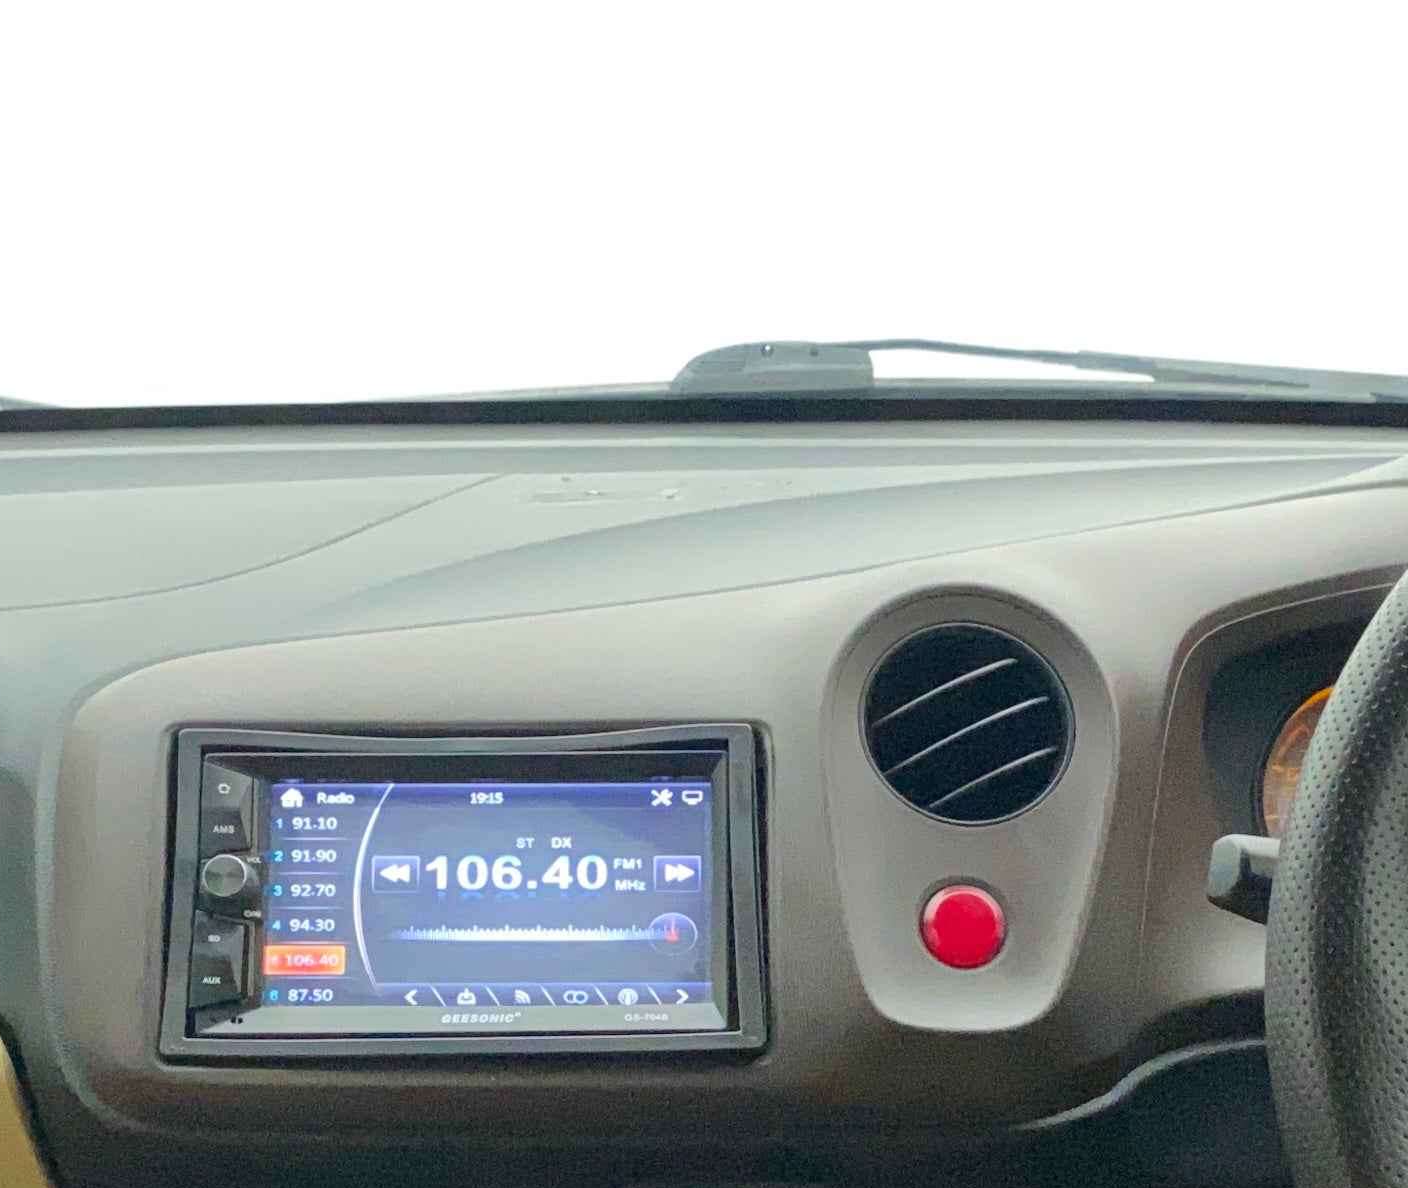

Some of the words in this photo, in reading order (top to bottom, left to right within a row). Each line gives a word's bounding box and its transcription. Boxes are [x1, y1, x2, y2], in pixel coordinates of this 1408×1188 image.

[317, 792, 355, 804] Radio
[470, 792, 504, 804] 19:15
[212, 824, 235, 834] AMS
[276, 819, 283, 829] 1
[292, 816, 338, 830] 91.10
[516, 837, 535, 849] ST
[551, 836, 573, 849] DX
[274, 851, 283, 861] 2
[291, 849, 337, 862] 91.90
[613, 859, 642, 869] FM1
[425, 855, 608, 890] 106.40
[273, 886, 282, 896] 3
[290, 884, 336, 897] 92.70
[615, 880, 646, 891] MHz
[272, 921, 281, 930] 4
[289, 919, 335, 932] 94.30
[284, 953, 339, 967] 106.40
[202, 976, 221, 984] AUX
[269, 991, 279, 1001] 6
[288, 988, 334, 1002] 87.50
